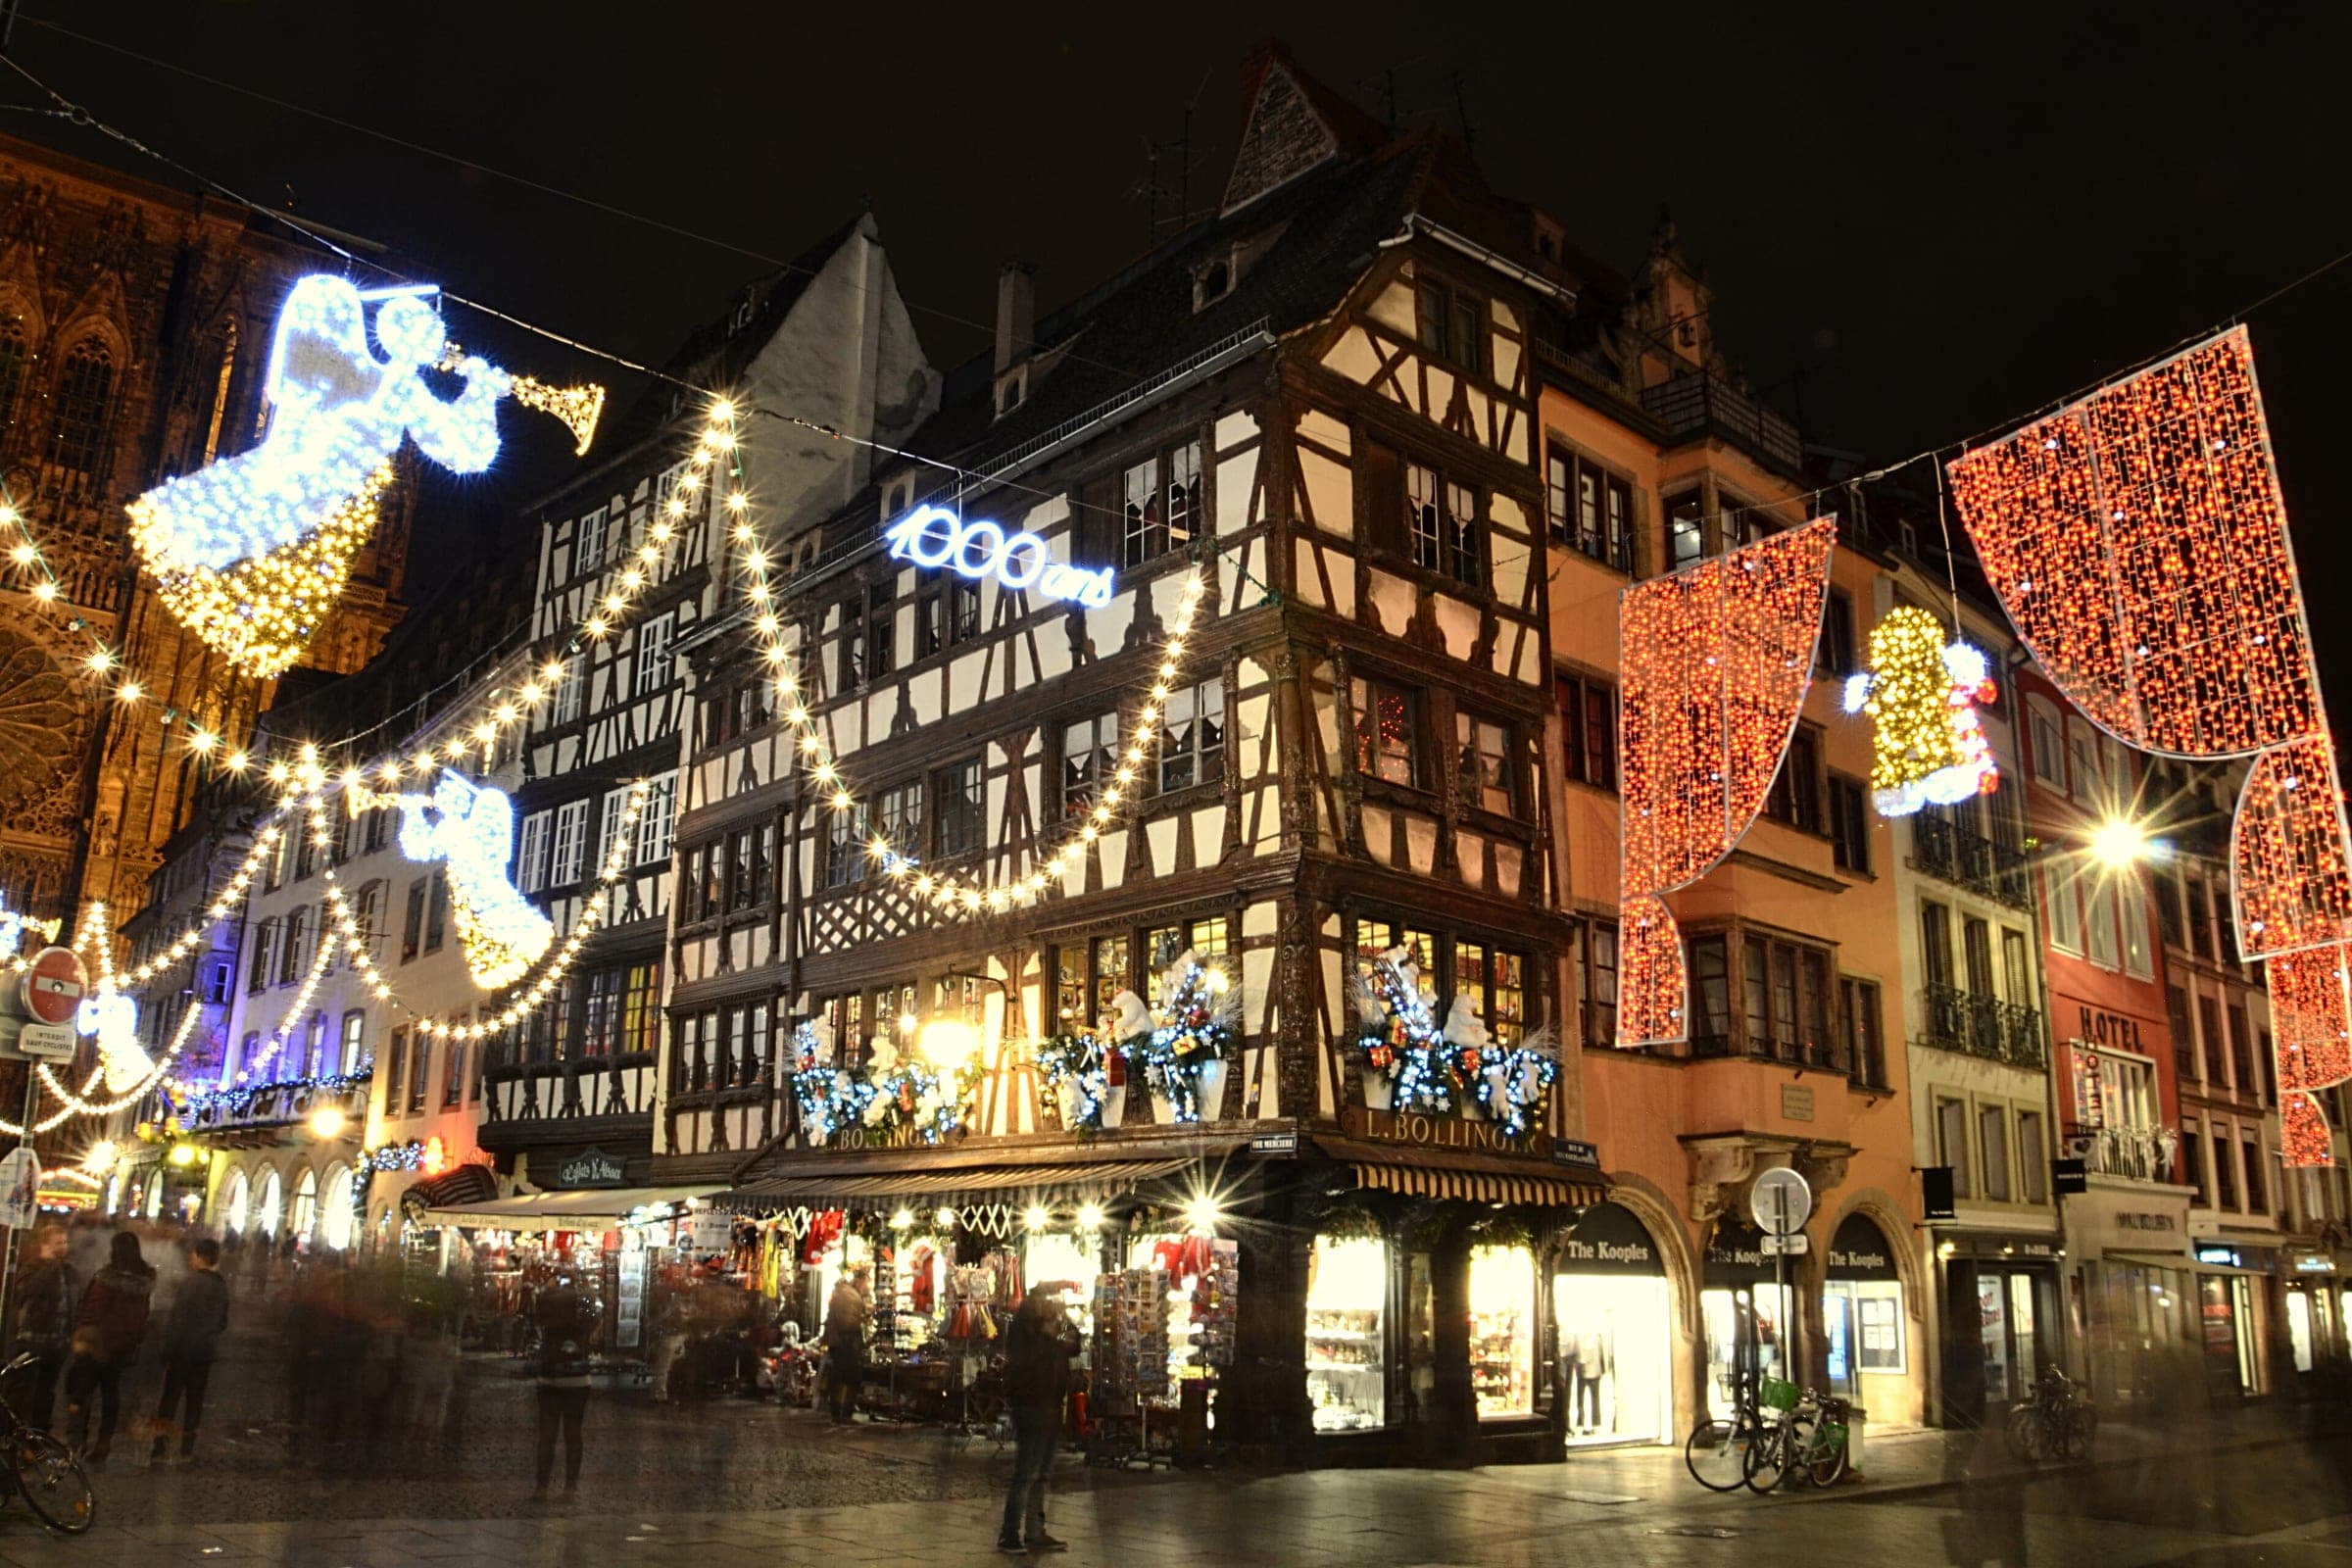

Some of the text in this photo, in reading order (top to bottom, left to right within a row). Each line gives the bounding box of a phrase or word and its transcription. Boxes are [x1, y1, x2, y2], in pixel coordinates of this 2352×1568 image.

[886, 504, 1049, 588] 1000
[2080, 1005, 2144, 1052] HOTEL
[840, 1124, 946, 1151] BOINGR
[1568, 1241, 1648, 1263] The Kooples
[1735, 1248, 1776, 1267] Koop
[1828, 1250, 1885, 1270] The Kooples
